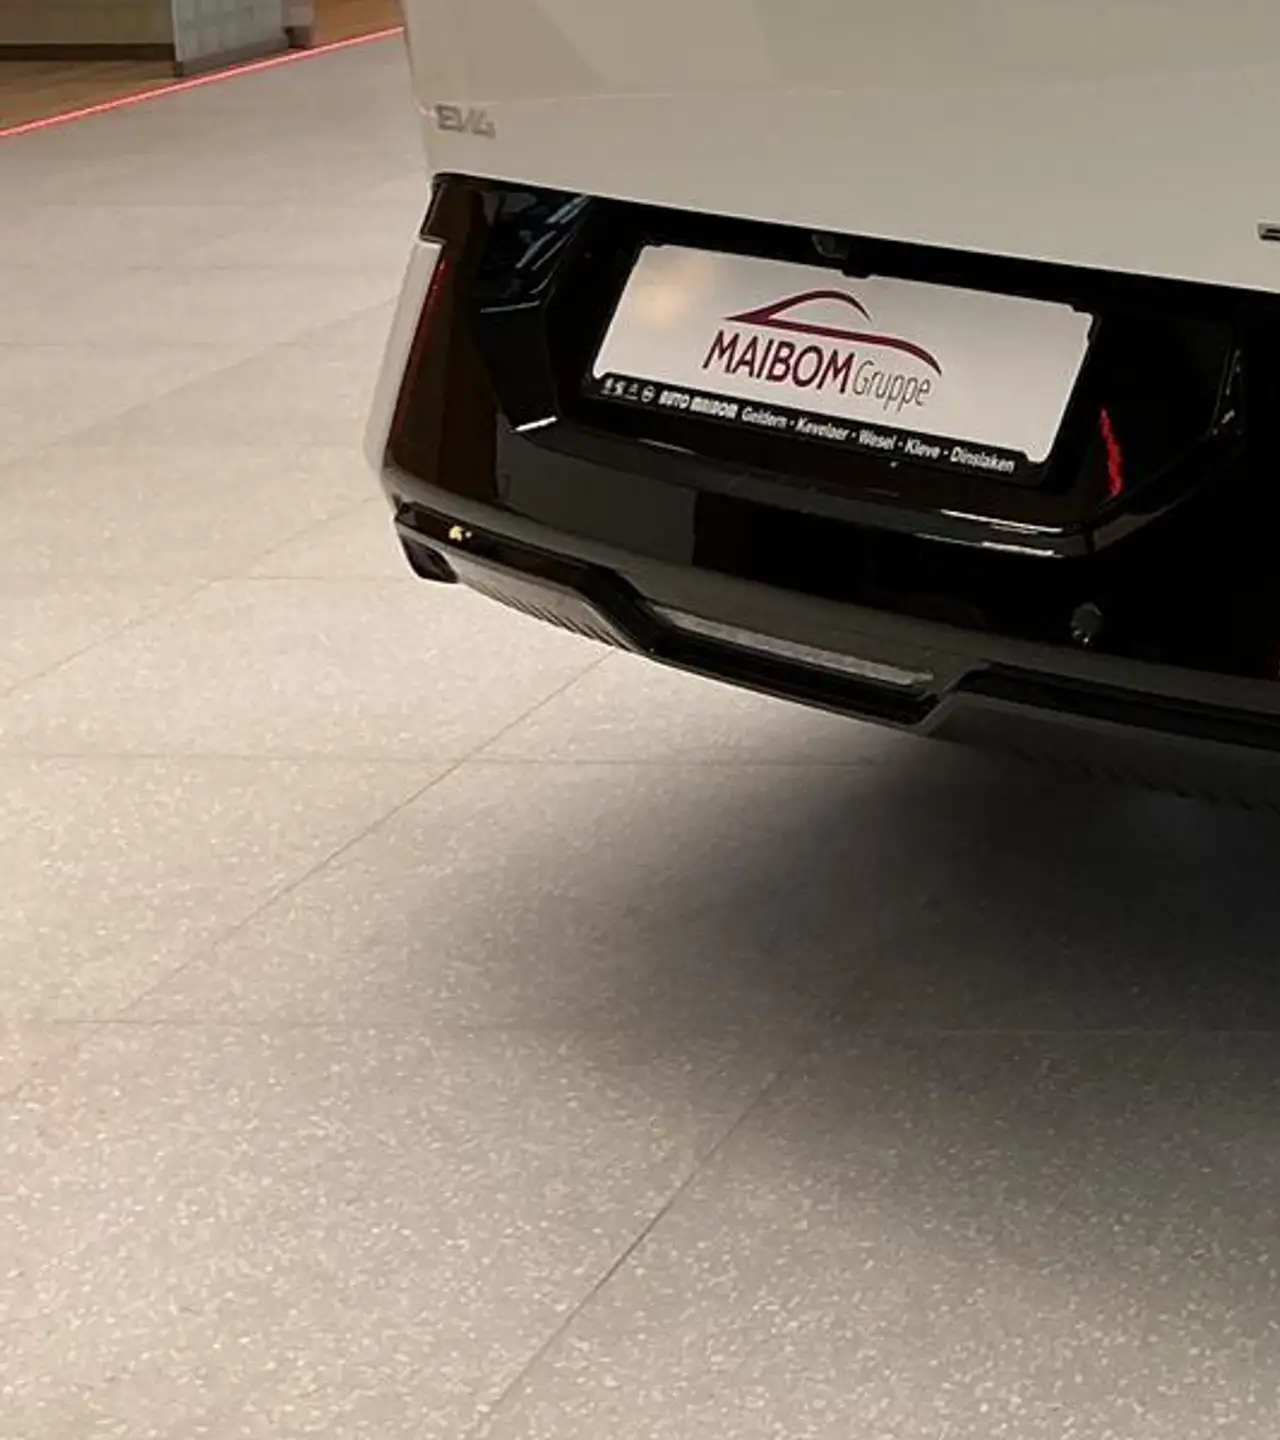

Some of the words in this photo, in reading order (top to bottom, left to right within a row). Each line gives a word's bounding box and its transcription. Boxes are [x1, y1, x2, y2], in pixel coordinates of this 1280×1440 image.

[435, 104, 497, 140] EV4
[702, 329, 855, 395] MAIBOM
[852, 360, 931, 412] Gruppe
[657, 390, 690, 409] AUTO
[741, 407, 788, 429] Geldern
[795, 417, 850, 442] Kevelaer
[857, 428, 897, 451] Wesel
[903, 437, 941, 460] Kleve
[950, 445, 1016, 473] Dinslaken
